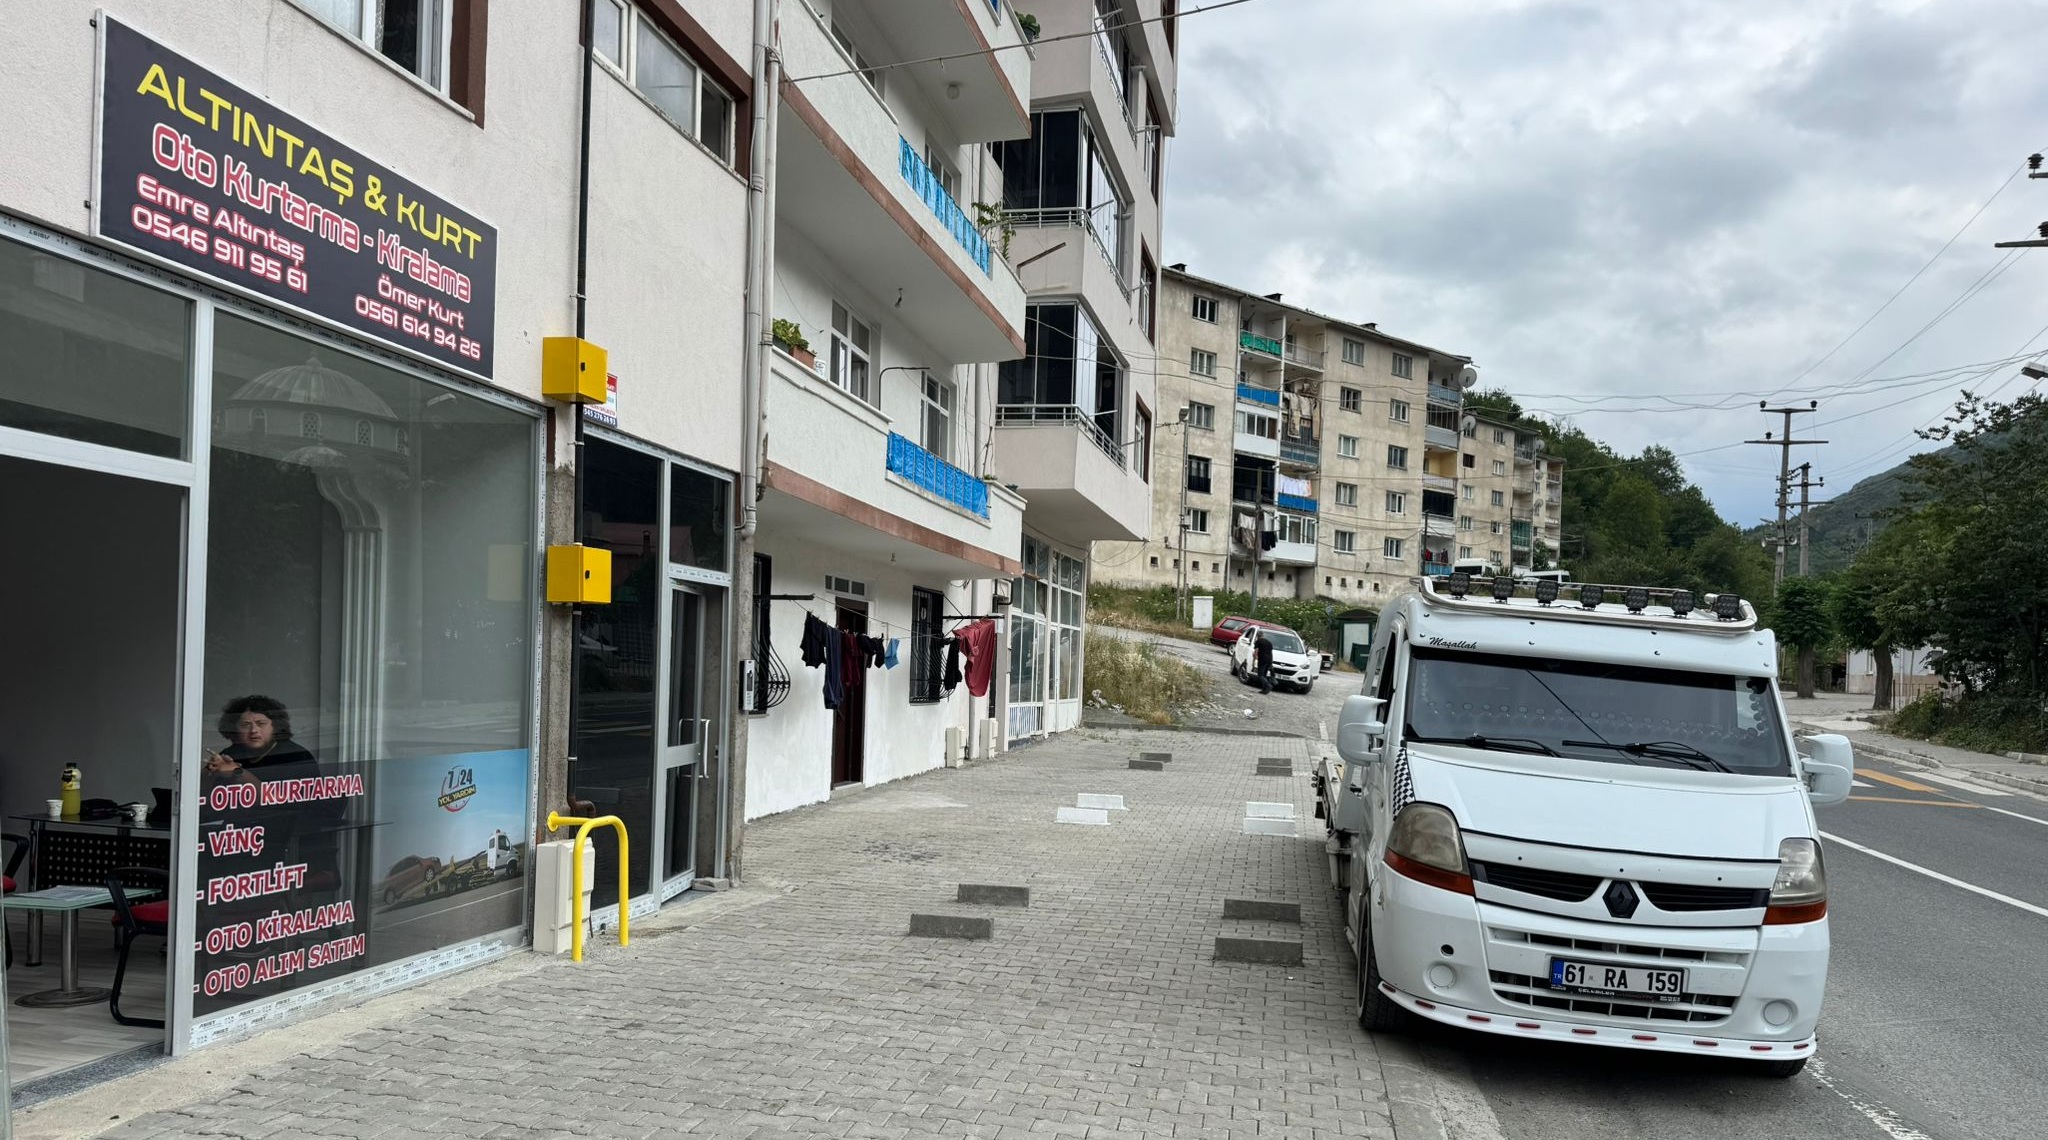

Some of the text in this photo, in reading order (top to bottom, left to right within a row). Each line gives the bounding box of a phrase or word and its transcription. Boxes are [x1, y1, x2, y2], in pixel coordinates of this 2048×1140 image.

[137, 63, 482, 259] ALTINTAŞ & KURT
[137, 173, 306, 270] Emre Altıntaş
[152, 122, 471, 304] Oto Kurtarma - Kiralama
[132, 204, 309, 294] 0546 911 95 61
[355, 294, 481, 361] 0561 614 94 26
[378, 273, 465, 331] Ömer Kurt
[1429, 636, 1477, 650] Maşallah
[210, 783, 257, 811] OTO
[260, 774, 364, 806] KURTARMA
[208, 823, 265, 857] VİNÇ
[208, 862, 308, 905] FORTLİFT
[206, 922, 253, 955] OTO
[256, 900, 355, 944] KİRALAMA
[204, 963, 251, 996] OTO
[252, 948, 305, 985] ALIM
[308, 933, 366, 969] SATIM
[1565, 964, 1586, 985] 61
[1604, 968, 1628, 989] RA
[1647, 972, 1679, 993] 159
